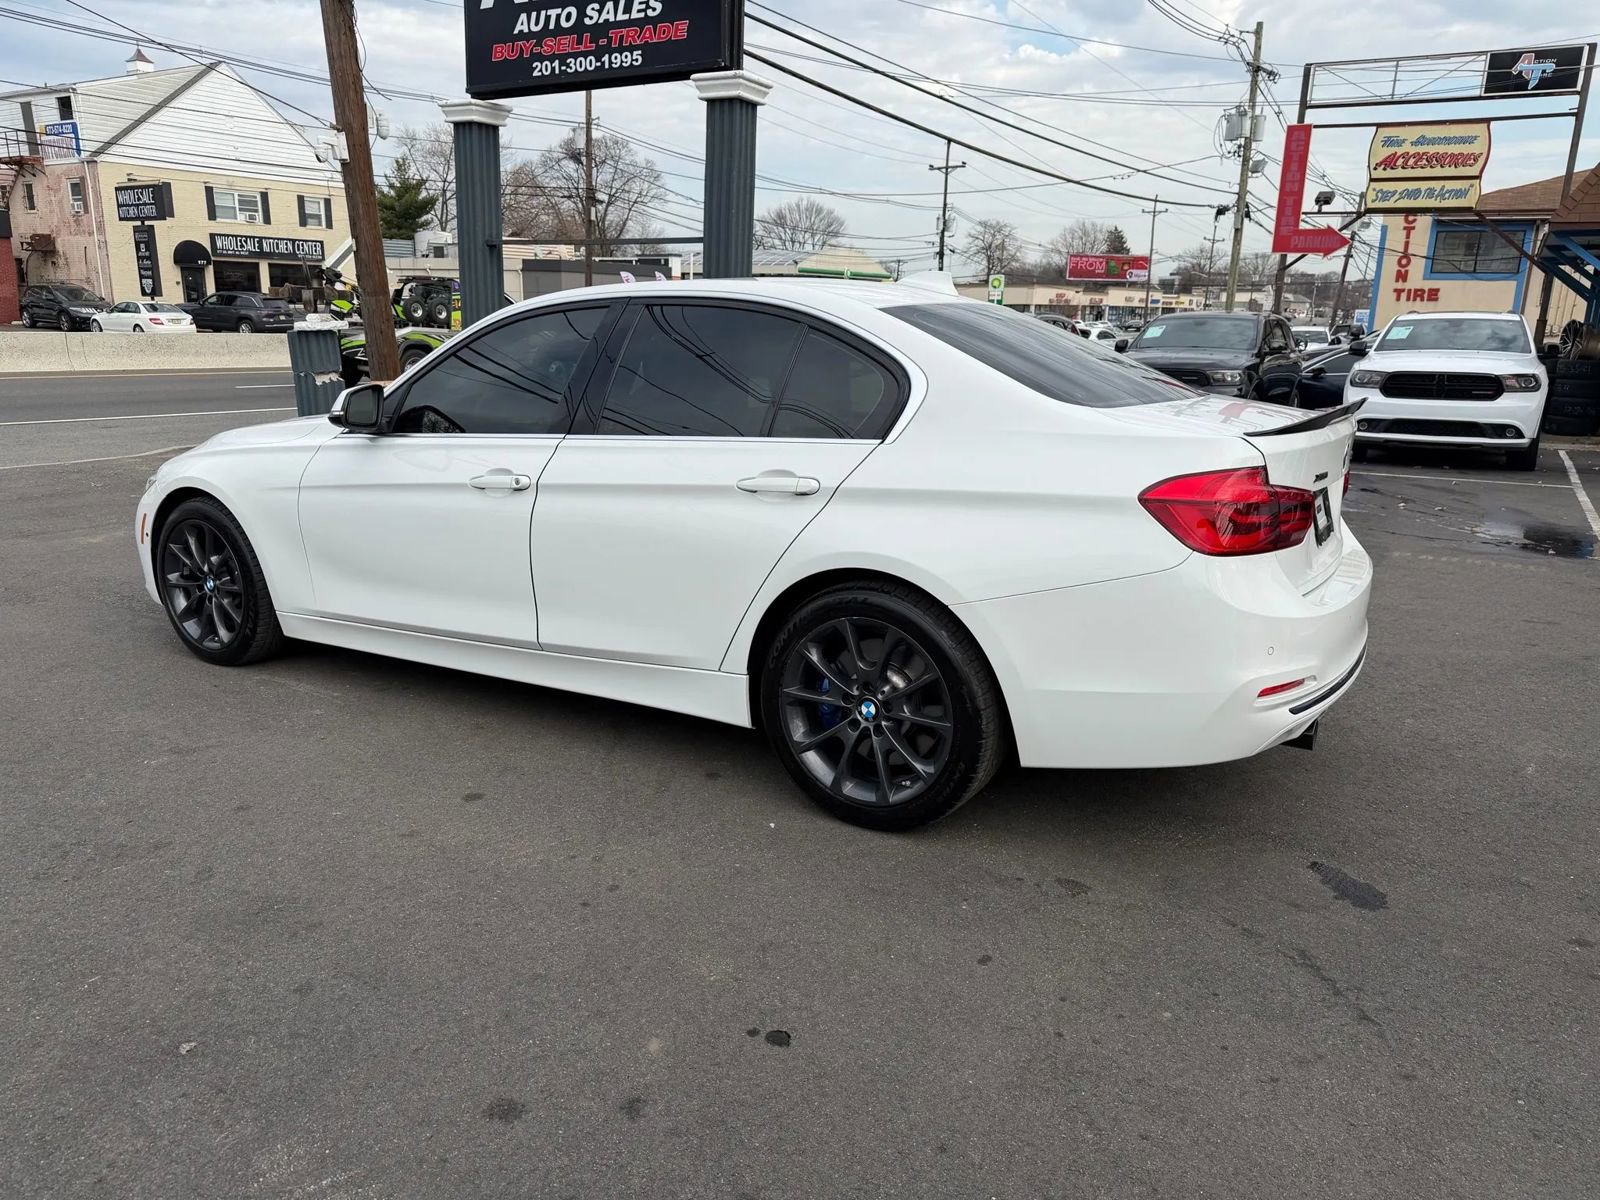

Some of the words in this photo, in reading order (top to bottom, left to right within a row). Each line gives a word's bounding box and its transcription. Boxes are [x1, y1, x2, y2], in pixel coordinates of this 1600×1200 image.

[512, 7, 577, 35] AUTO
[584, 0, 664, 25] SALES
[531, 50, 643, 77] 201-300-1995
[1373, 151, 1484, 171] ACCESSORIES
[117, 188, 156, 205] WHOLESALE
[119, 206, 139, 218] KITCHEN
[139, 205, 158, 217] CENTER
[215, 235, 261, 252] WHOLESALE
[262, 238, 294, 254] KITCHEN
[295, 240, 323, 256] CENTER
[1395, 213, 1418, 283] CTION
[1070, 260, 1106, 271] FROM
[1393, 288, 1441, 302] TIRE
